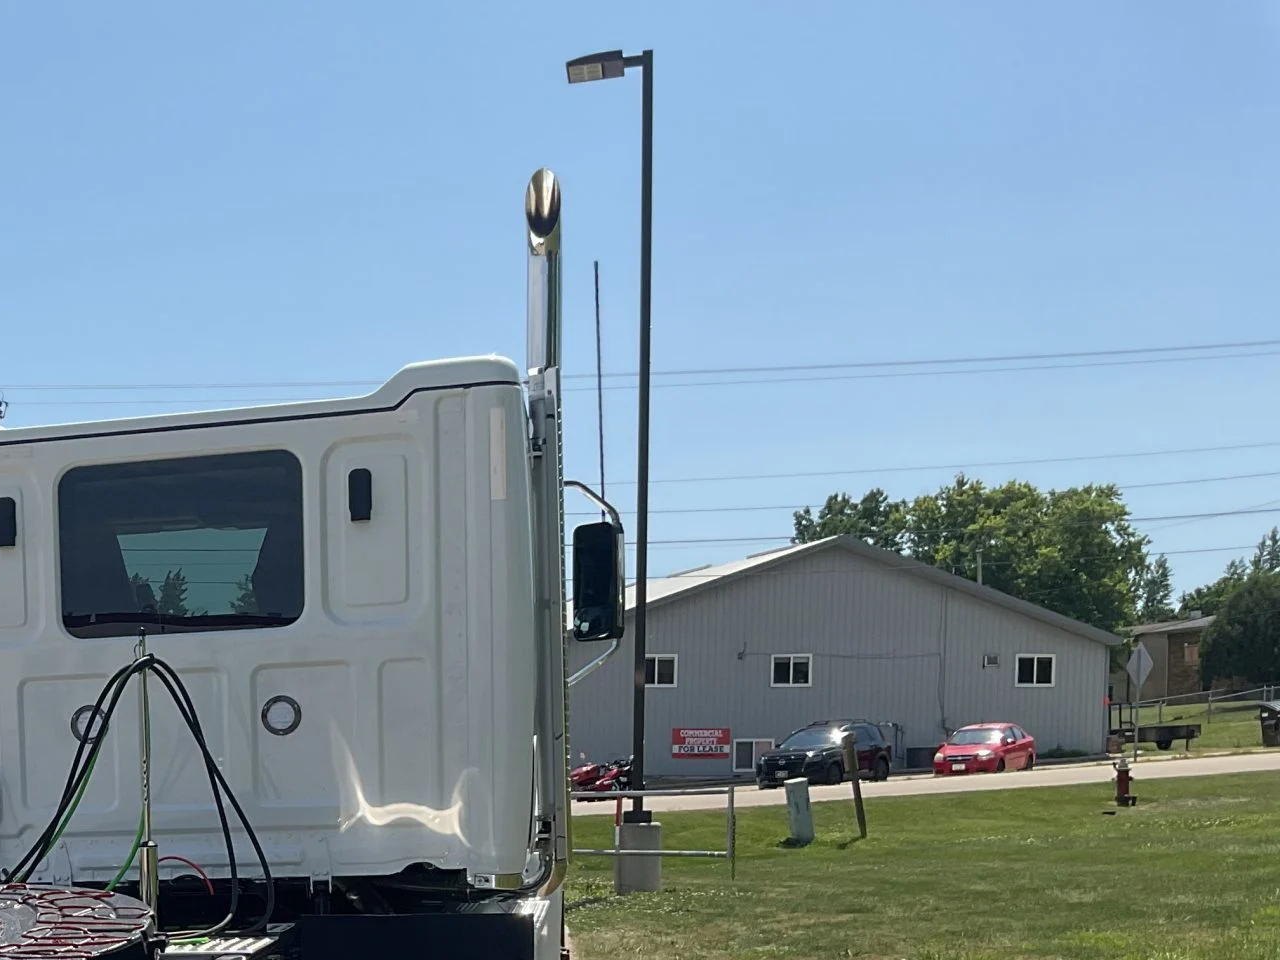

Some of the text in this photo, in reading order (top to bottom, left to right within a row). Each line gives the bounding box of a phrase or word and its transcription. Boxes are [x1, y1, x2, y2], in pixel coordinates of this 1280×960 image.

[680, 729, 724, 738] COMMERCIAL
[678, 745, 725, 753] FOR LEASE
